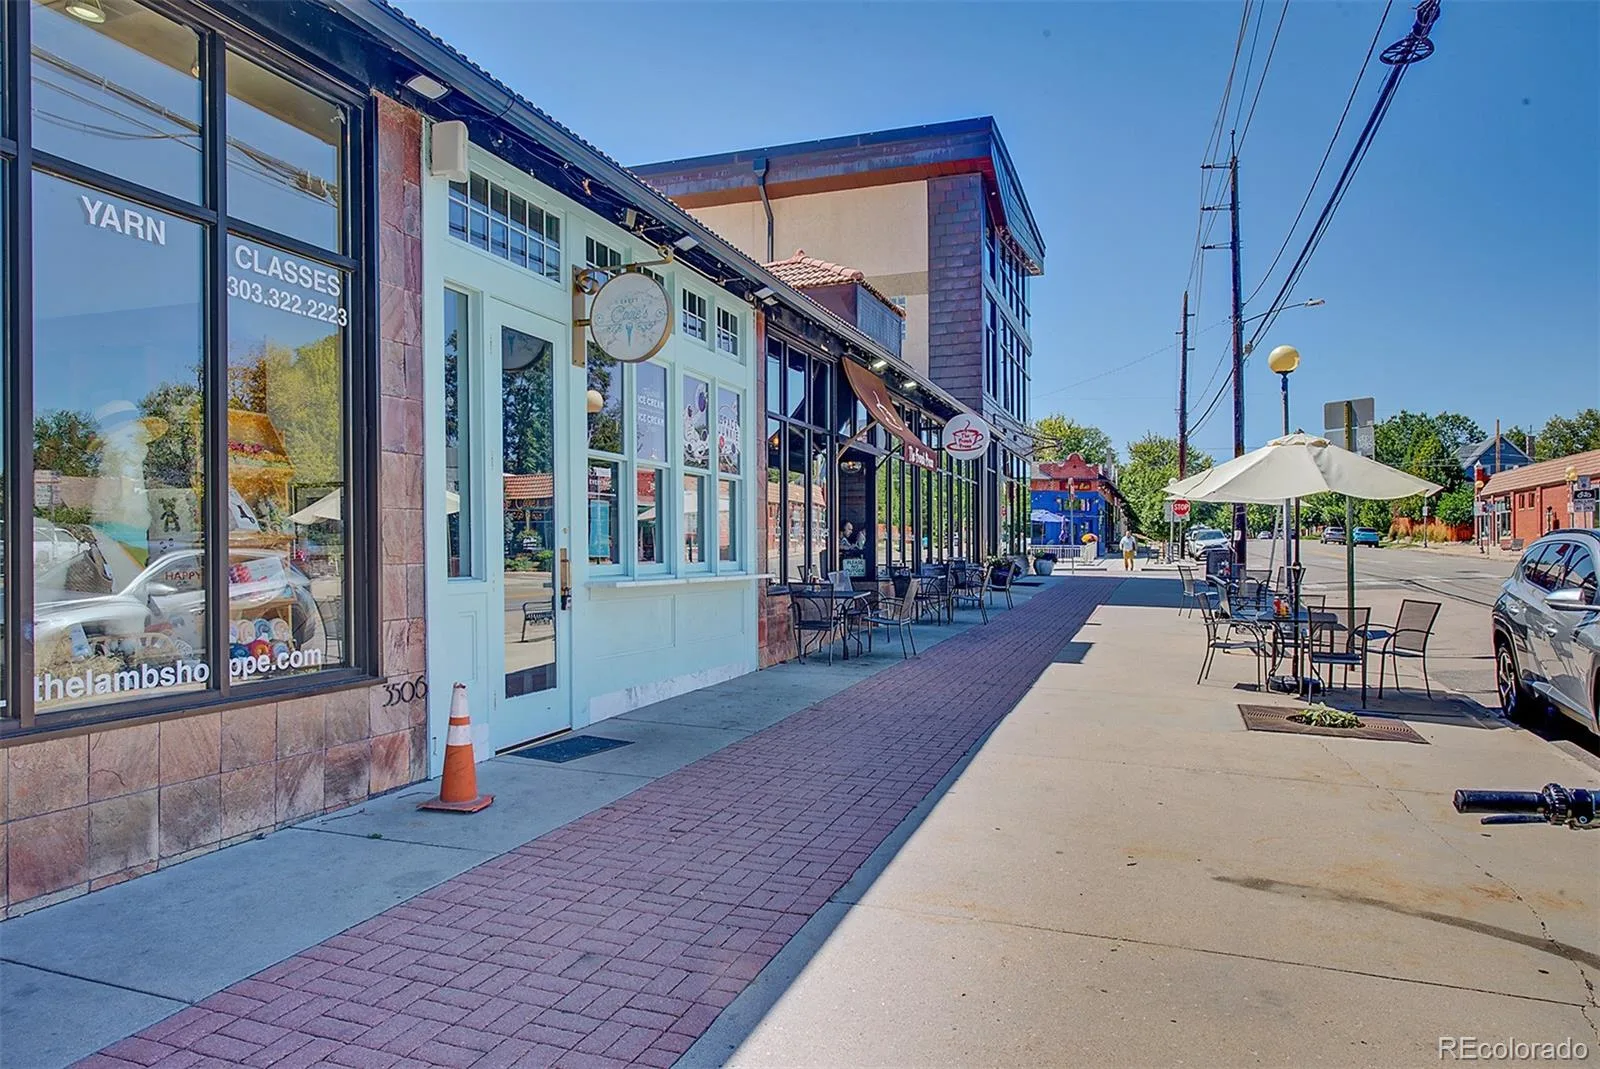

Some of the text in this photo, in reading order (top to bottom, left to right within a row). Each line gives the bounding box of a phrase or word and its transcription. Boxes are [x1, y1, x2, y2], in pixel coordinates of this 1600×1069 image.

[81, 195, 166, 246] YARN
[235, 244, 341, 297] CLASSES
[226, 275, 348, 327] 303.322.2223
[1174, 503, 1189, 511] STOP
[165, 571, 201, 581] HAPPY
[382, 675, 428, 707] 3506
